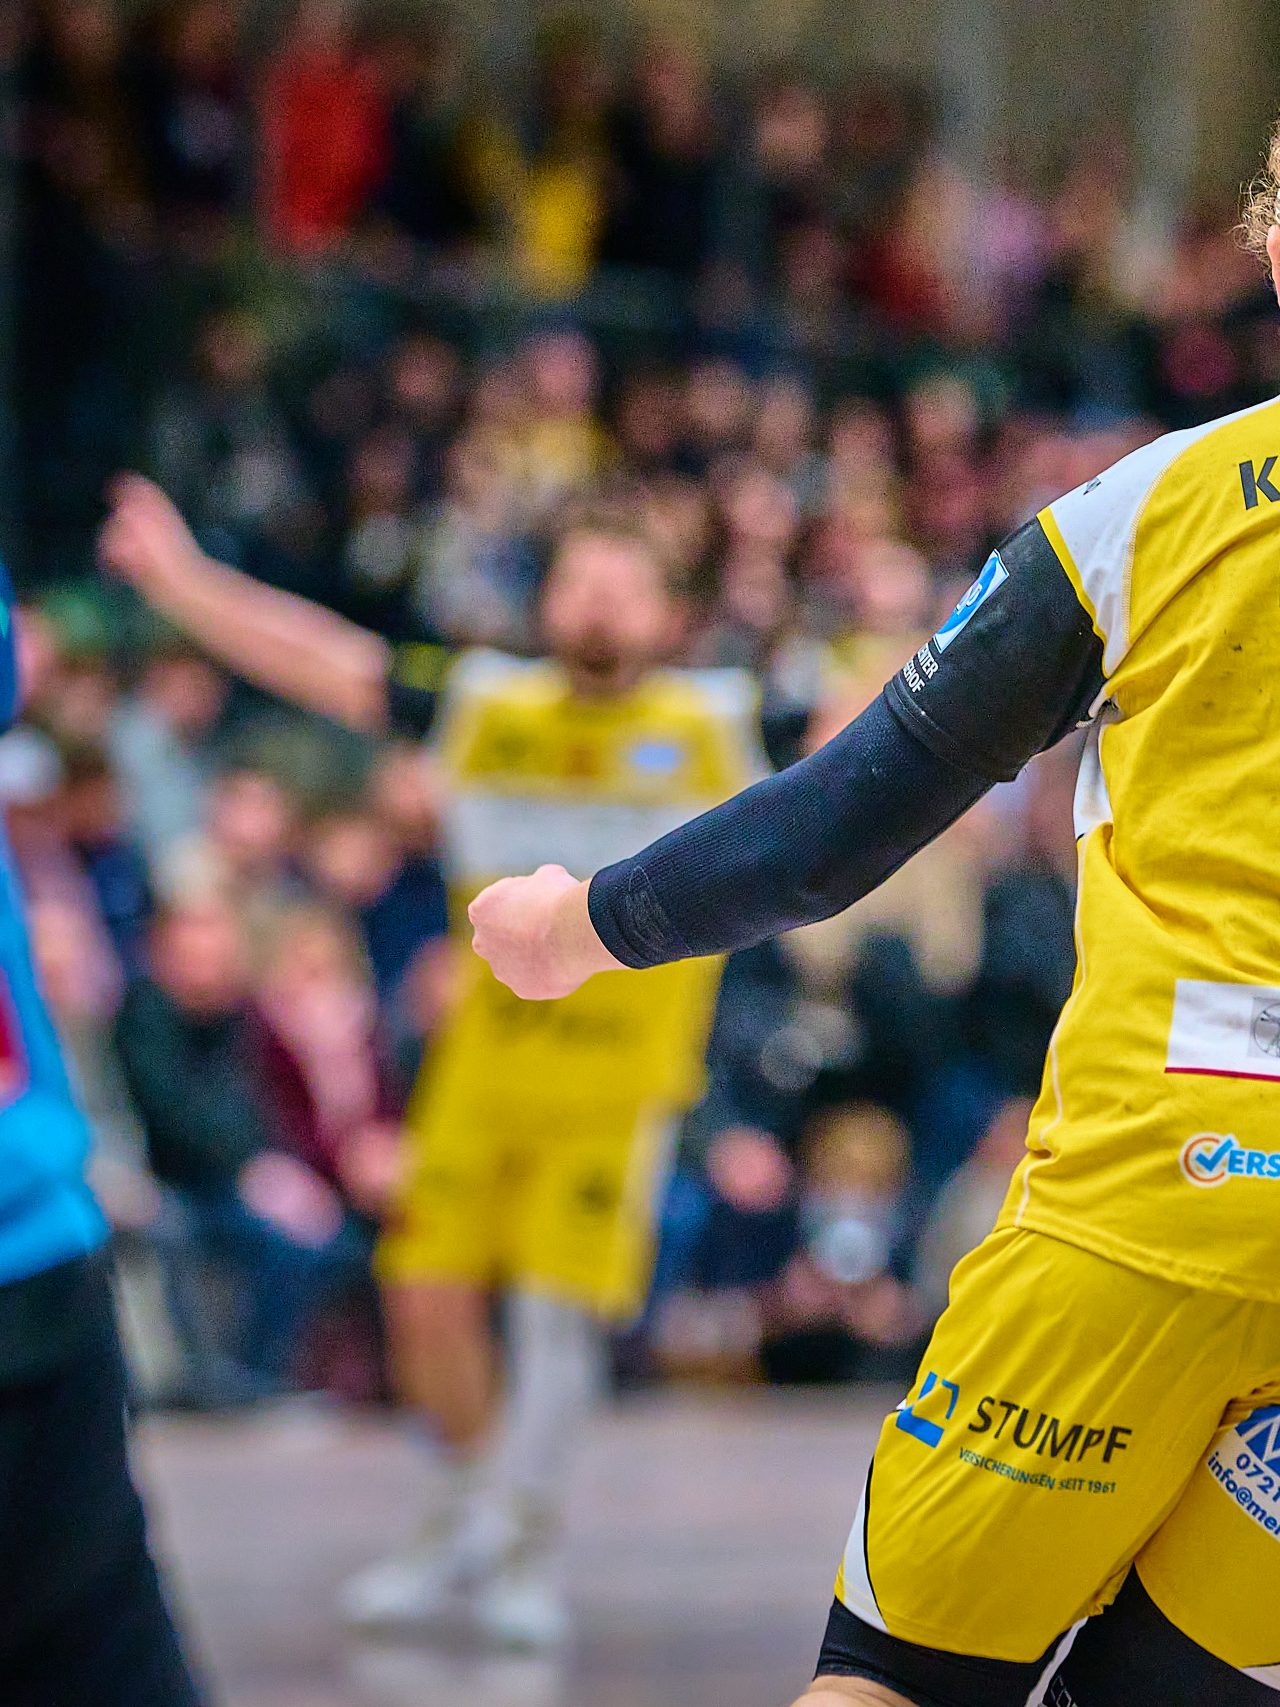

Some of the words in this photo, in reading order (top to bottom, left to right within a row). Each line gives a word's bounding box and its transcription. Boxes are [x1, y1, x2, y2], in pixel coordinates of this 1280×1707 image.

[968, 1396, 1132, 1464] STUMPF
[959, 1446, 1056, 1490] VERSICHERUNGEN
[1058, 1477, 1086, 1491] SEIT
